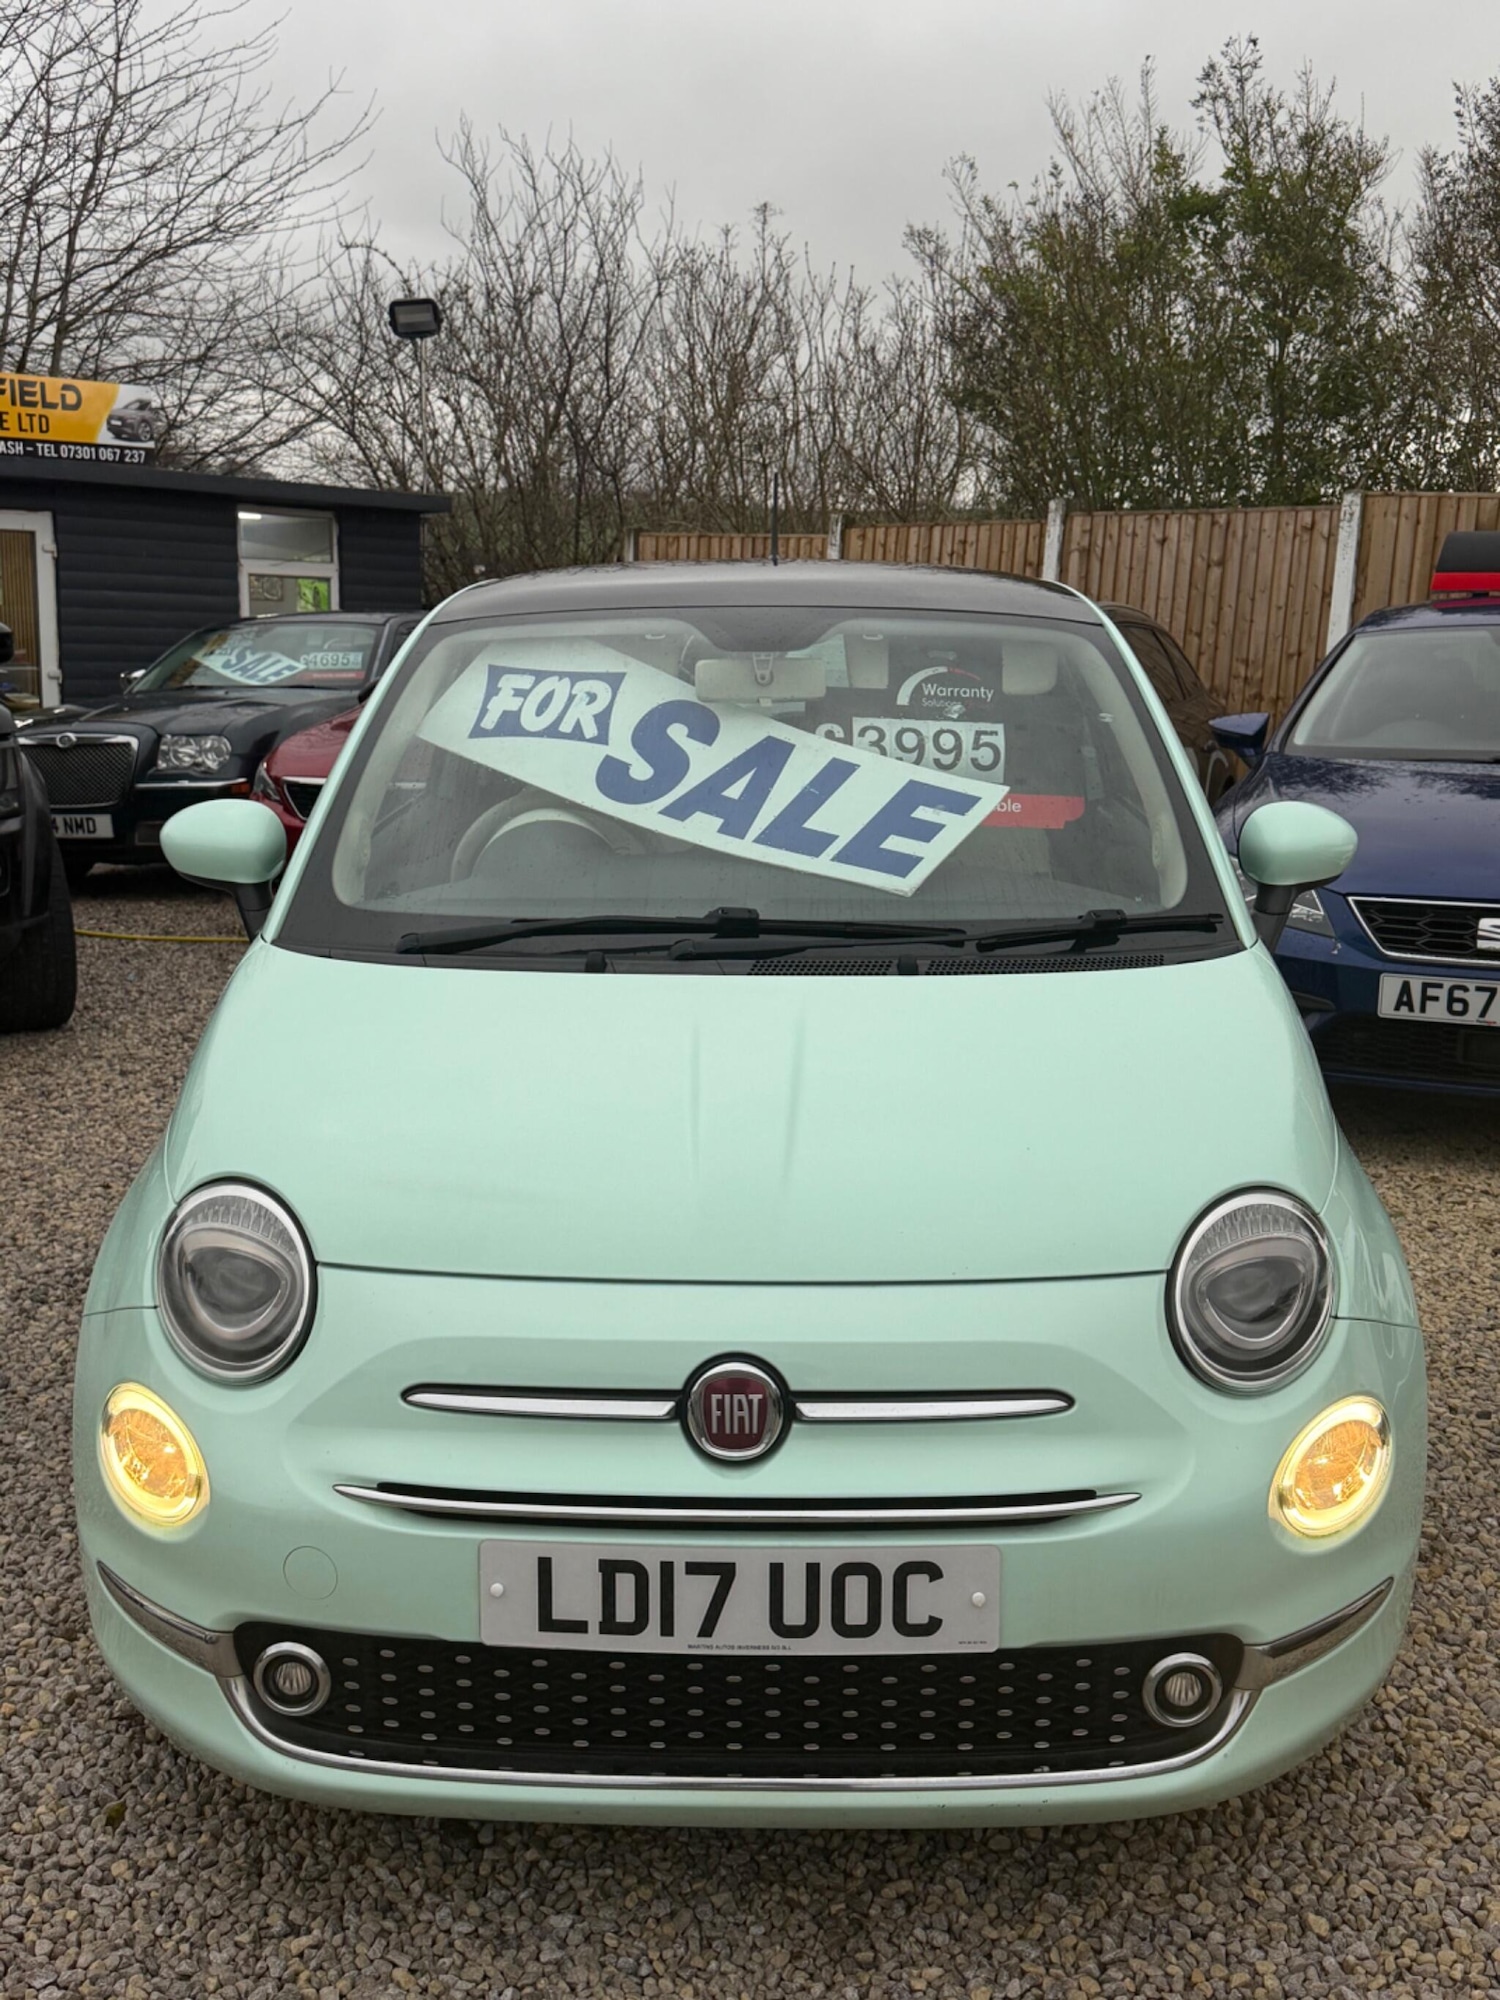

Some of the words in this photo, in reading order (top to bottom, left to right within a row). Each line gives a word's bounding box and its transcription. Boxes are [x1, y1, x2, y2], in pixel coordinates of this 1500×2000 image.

[17, 412, 50, 434] LTD
[36, 442, 58, 458] TEL
[60, 444, 97, 460] 07301
[99, 447, 121, 462] 067
[124, 450, 146, 464] 237
[221, 647, 299, 683] SALE
[922, 682, 995, 702] Warranty
[482, 673, 613, 740] FOR
[595, 699, 983, 879] SALE
[62, 816, 97, 834] NMD
[1393, 980, 1498, 1019] AF67
[711, 1393, 763, 1434] FIAT
[537, 1556, 737, 1638] LD17
[769, 1560, 944, 1639] UOC
